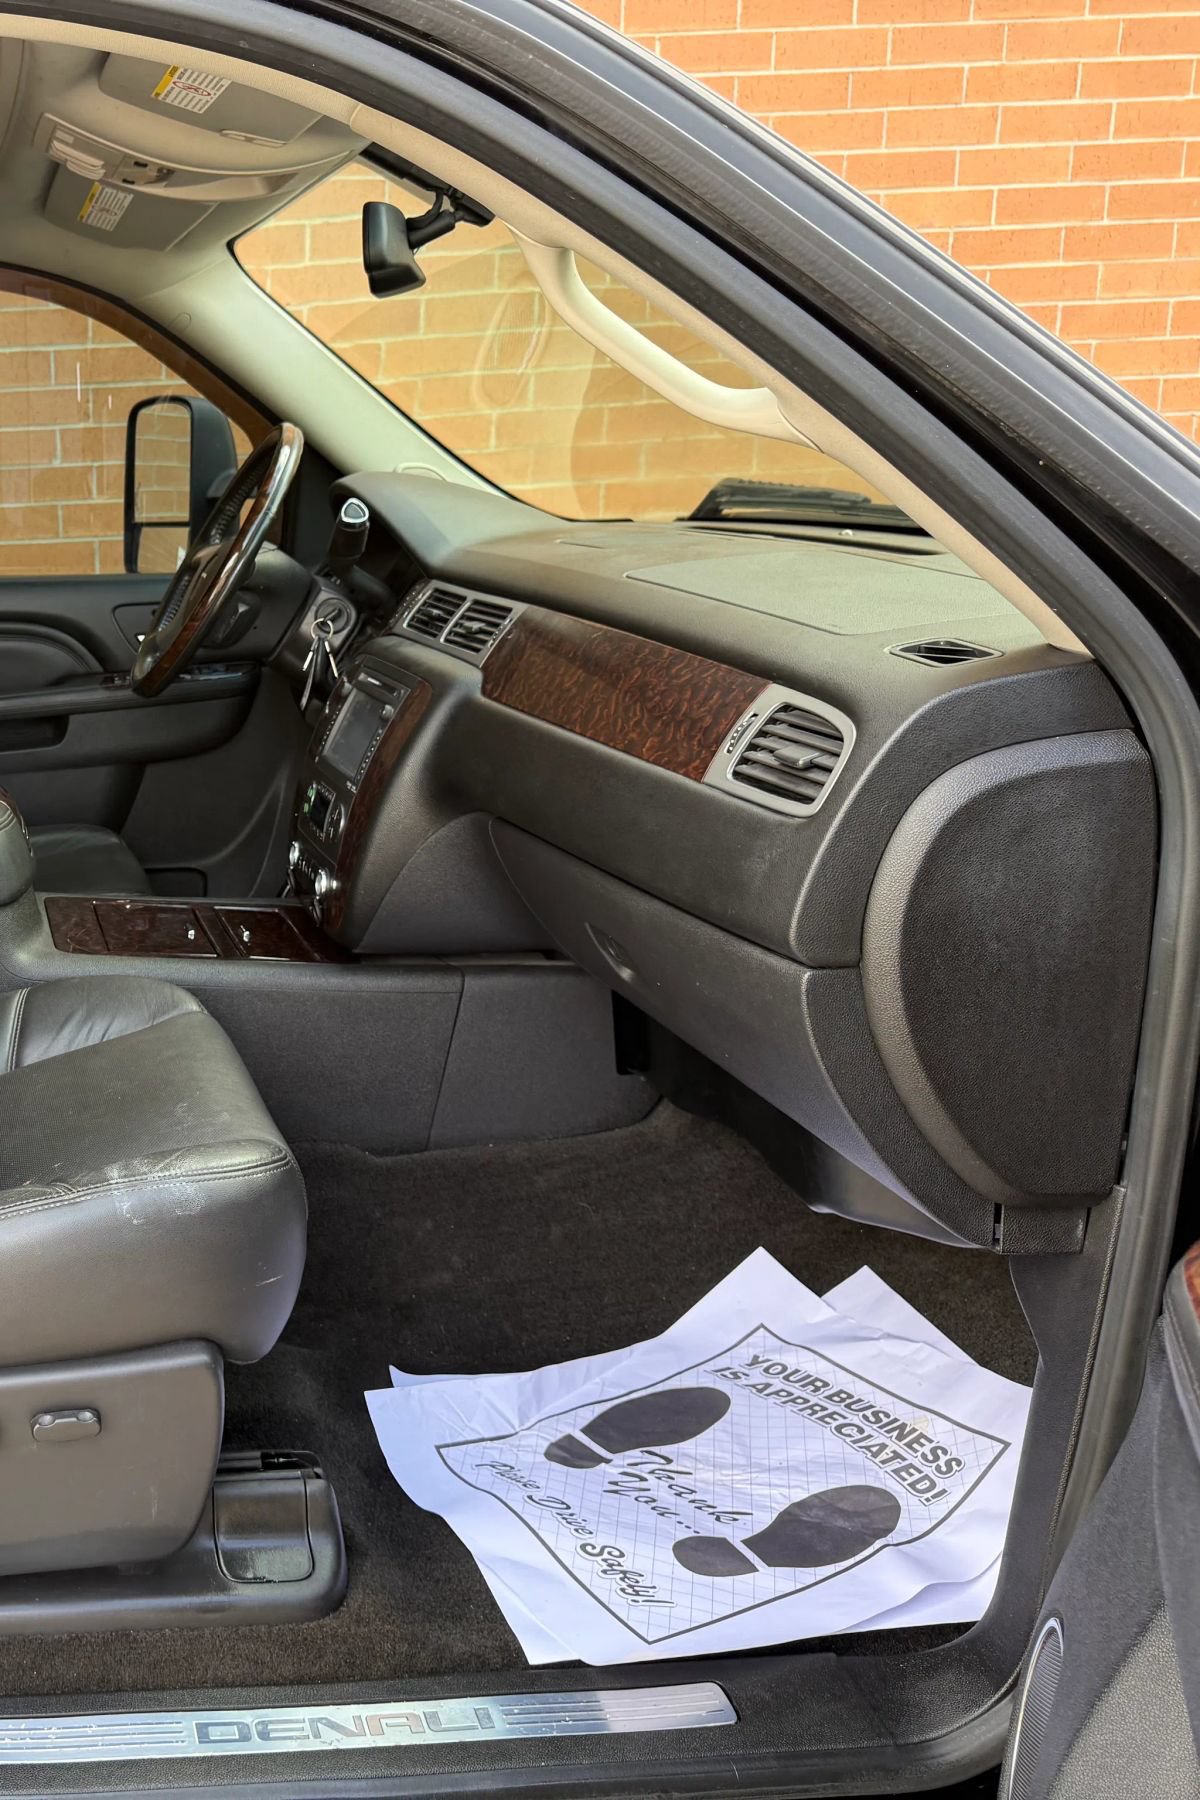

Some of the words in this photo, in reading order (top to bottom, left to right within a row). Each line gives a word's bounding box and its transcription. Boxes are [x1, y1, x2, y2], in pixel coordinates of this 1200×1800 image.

[707, 1366, 749, 1384] IS
[742, 1382, 951, 1506] APPRECIATED!
[741, 1354, 833, 1396] YOUR
[822, 1388, 965, 1479] BUSINESS
[627, 1450, 753, 1524] Thank
[527, 1495, 594, 1537] Drive
[578, 1541, 676, 1607] Safely!
[194, 1706, 496, 1745] DENALI
